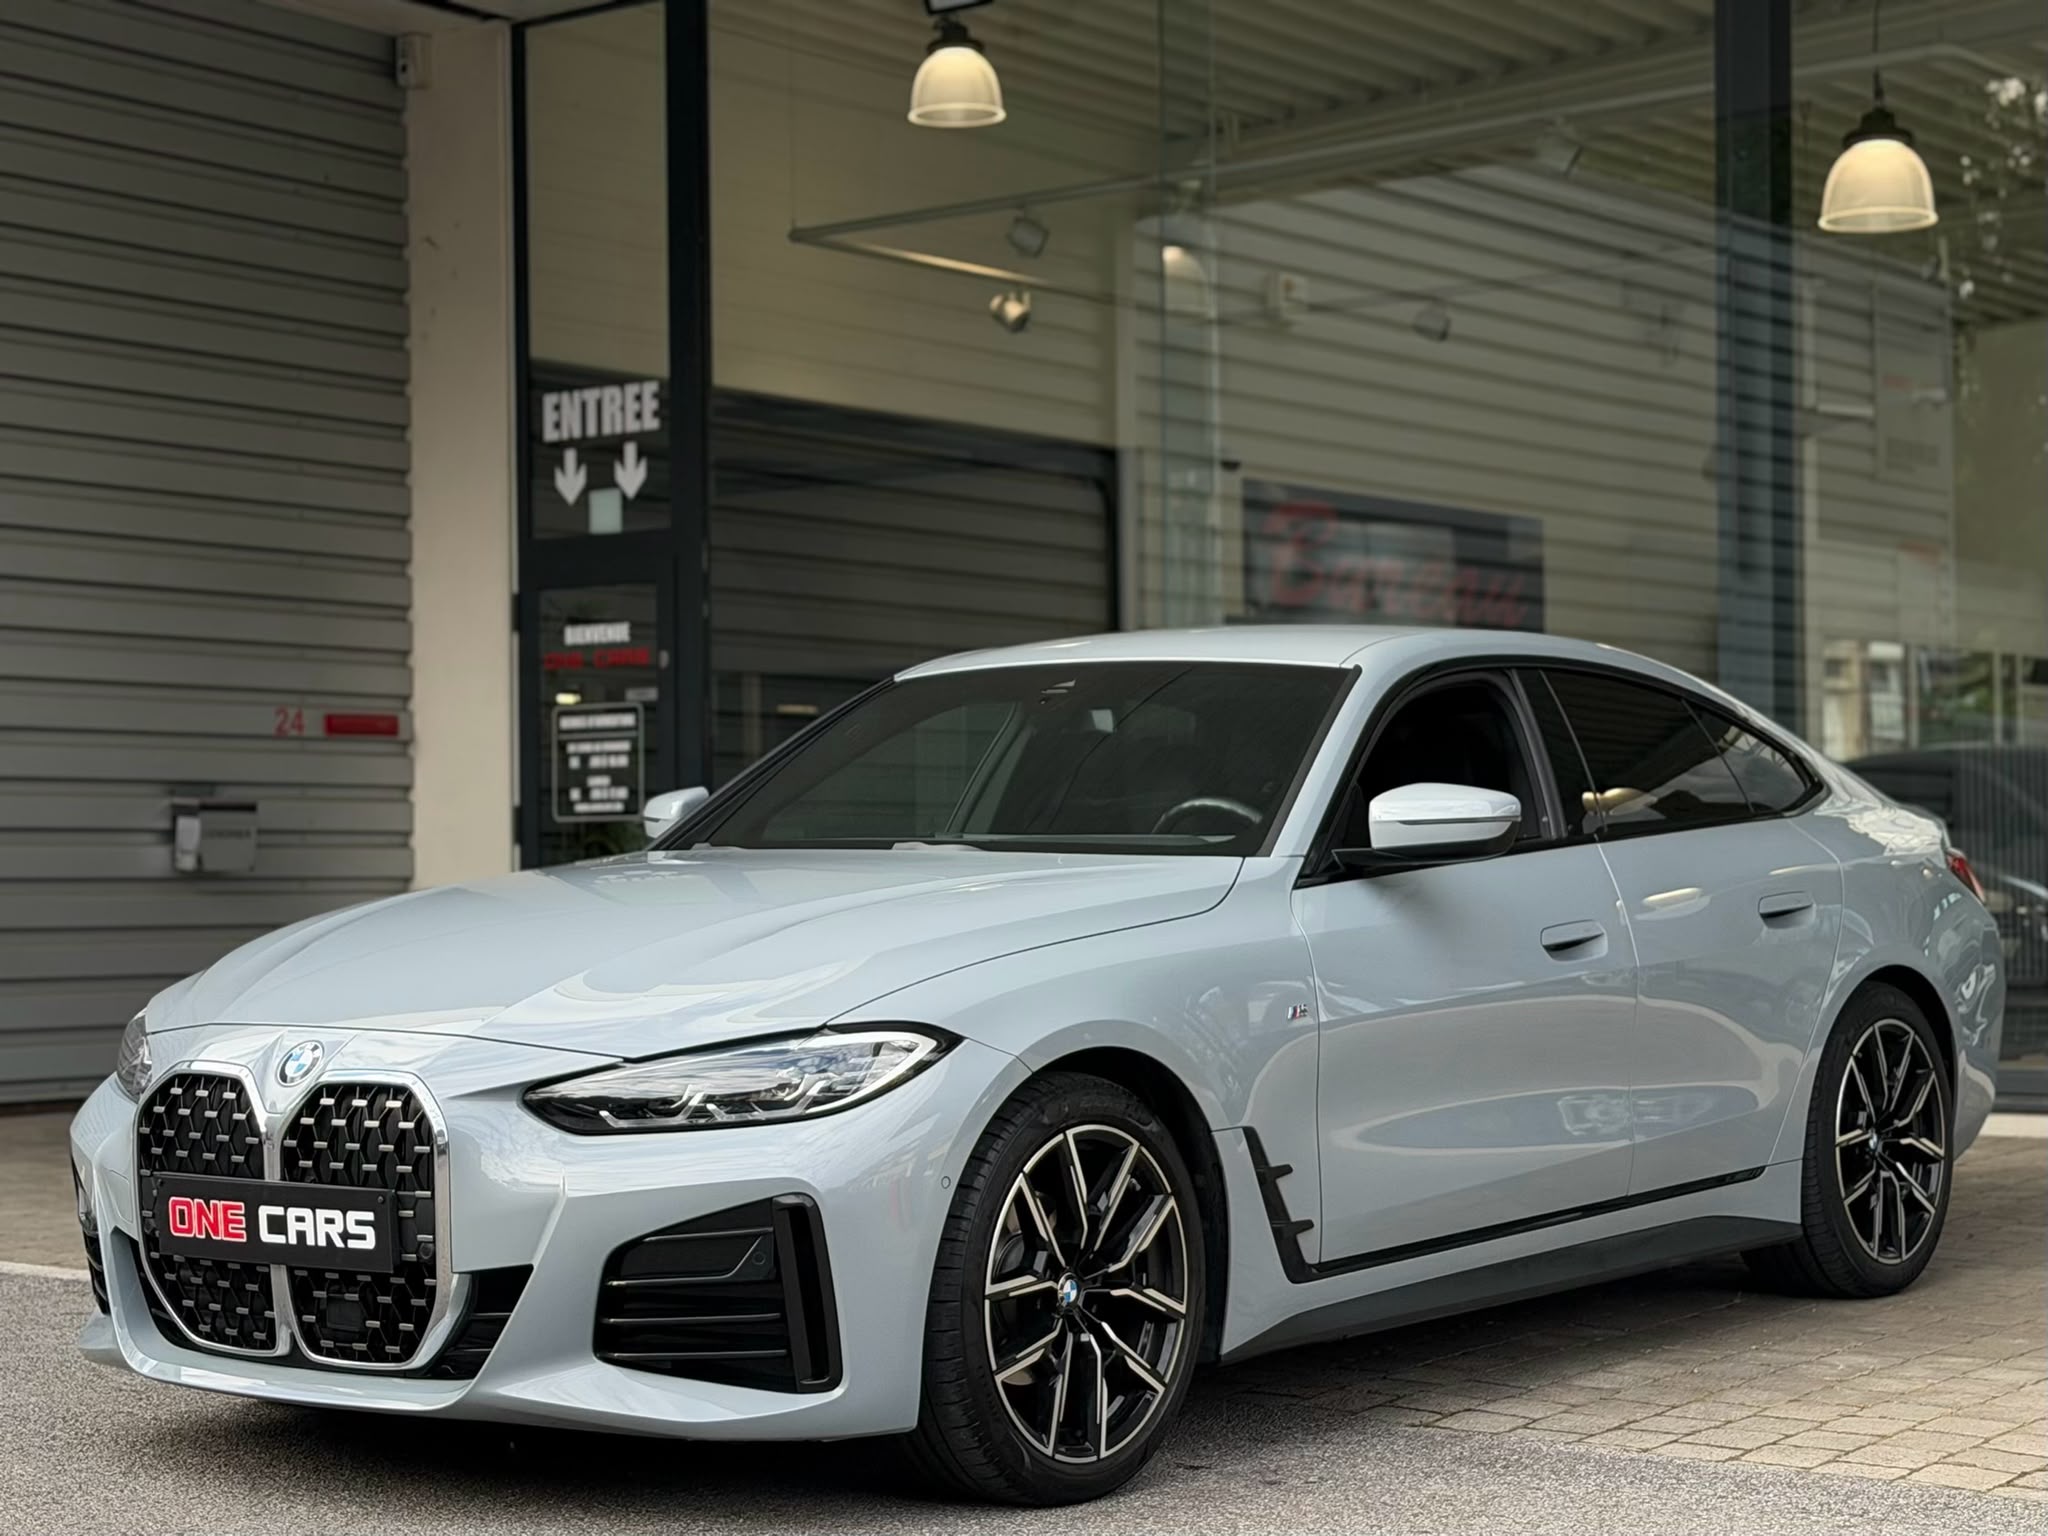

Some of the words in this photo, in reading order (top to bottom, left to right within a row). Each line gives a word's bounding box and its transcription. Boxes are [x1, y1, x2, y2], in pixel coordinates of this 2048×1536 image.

[542, 380, 661, 443] ENTREE
[274, 707, 306, 737] 24
[168, 1196, 247, 1243] ONE
[258, 1205, 376, 1250] CARS
